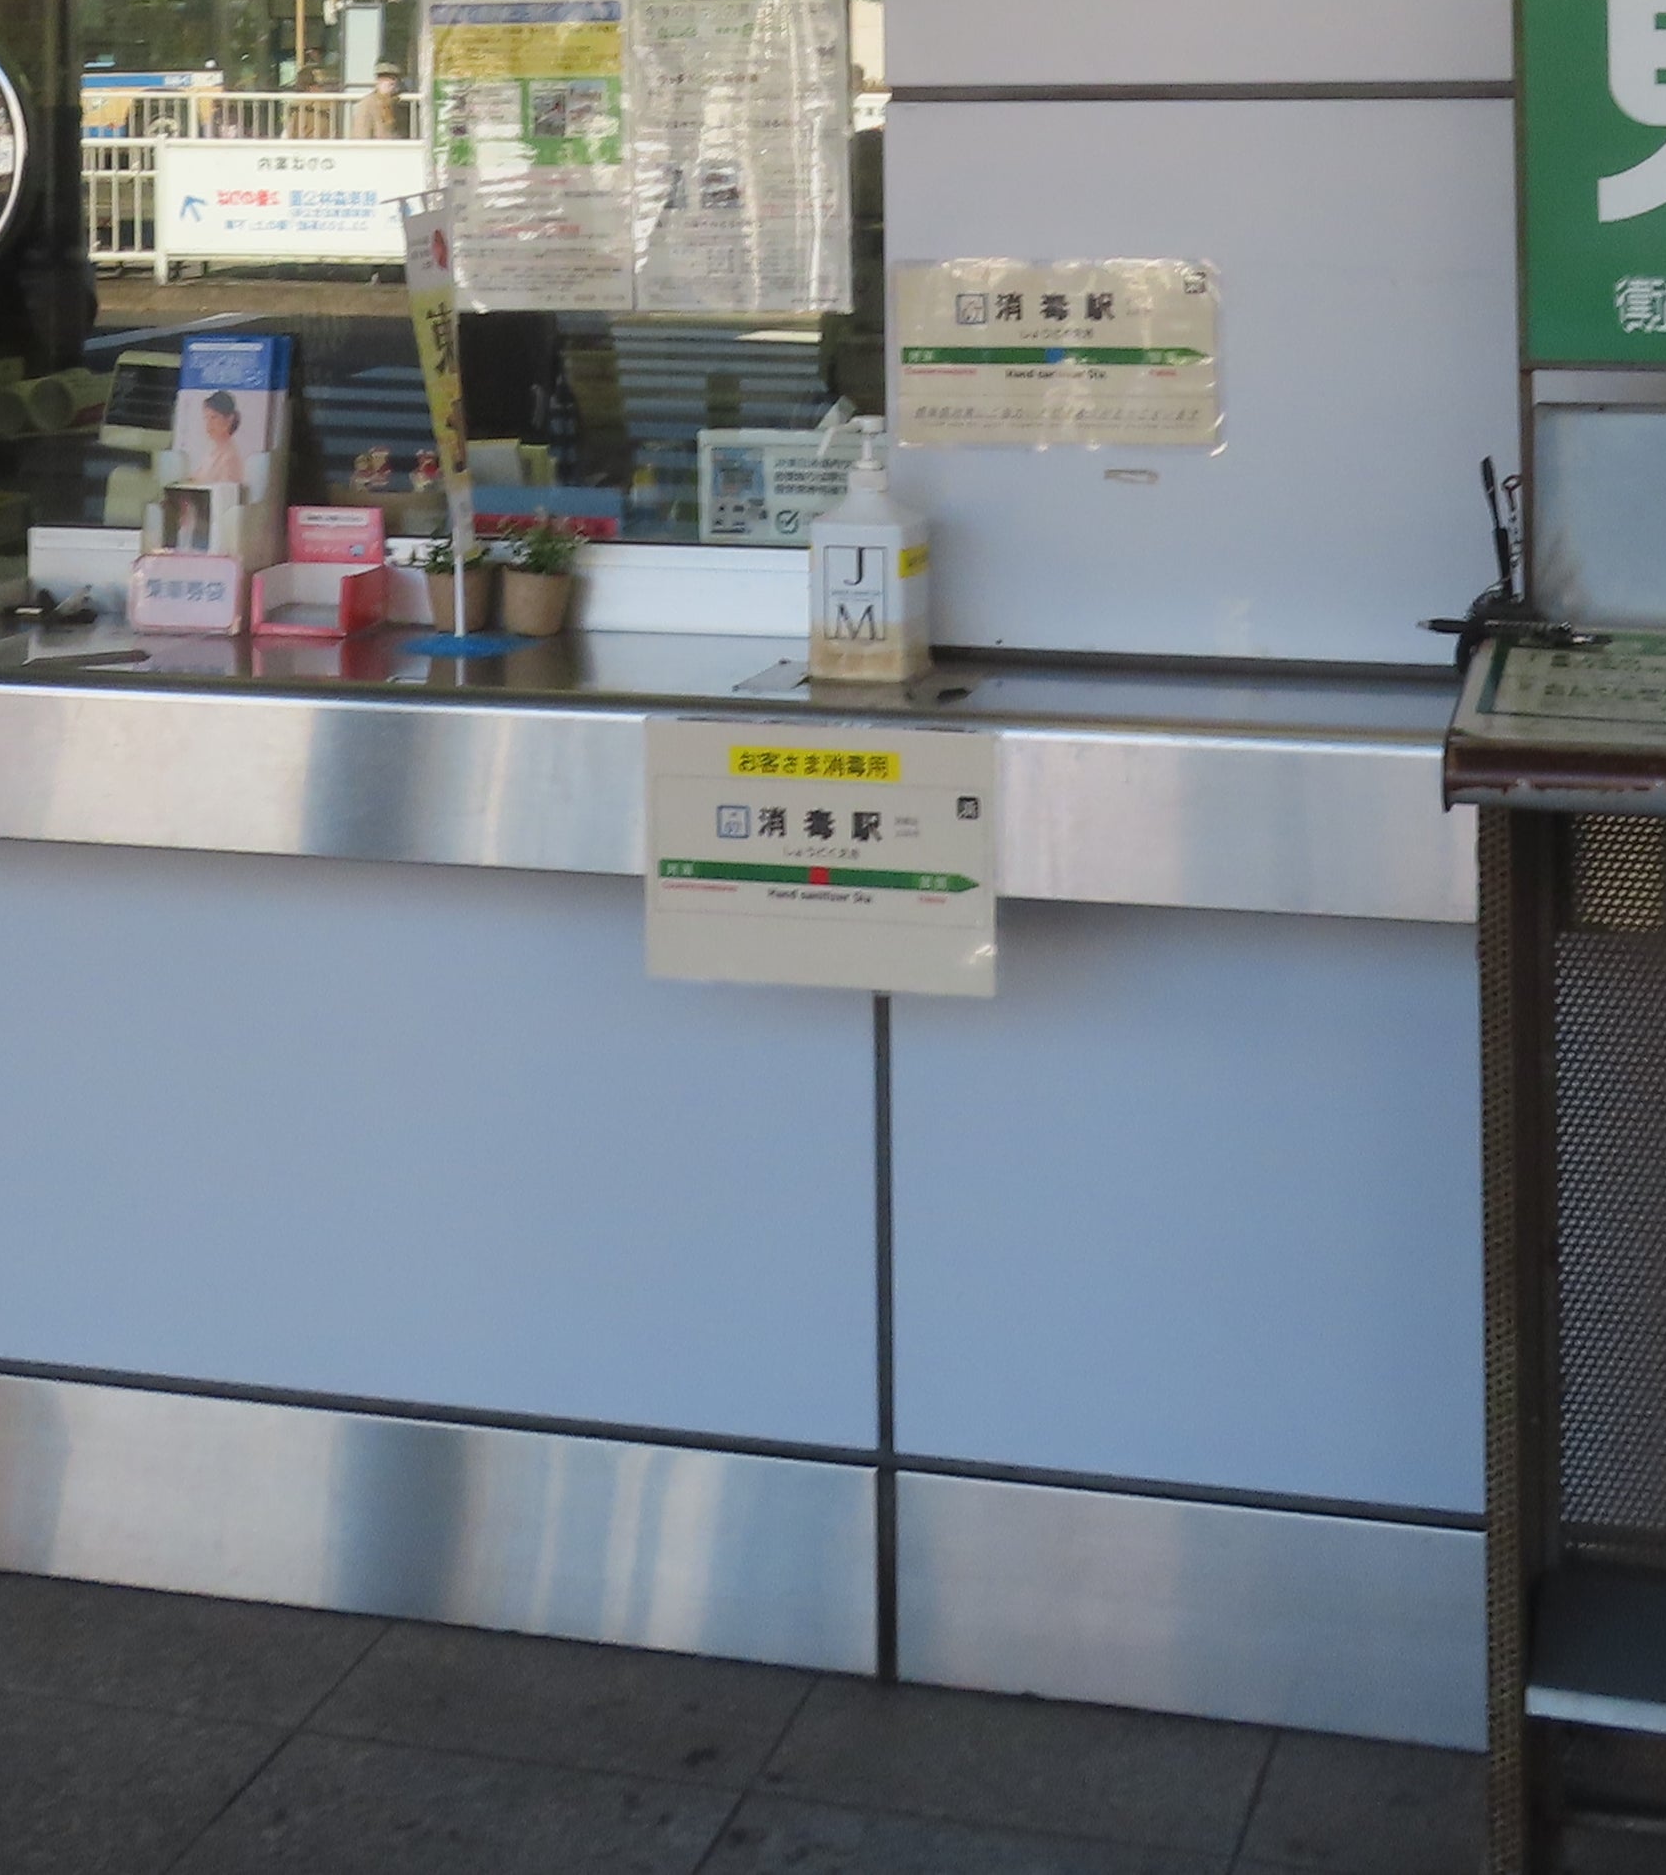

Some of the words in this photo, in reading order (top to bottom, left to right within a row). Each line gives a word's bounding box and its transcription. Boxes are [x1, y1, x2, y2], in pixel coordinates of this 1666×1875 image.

[843, 546, 867, 587] J
[833, 604, 878, 641] M
[738, 751, 891, 779] お客さま消毒用
[756, 806, 883, 842] 消毒駅
